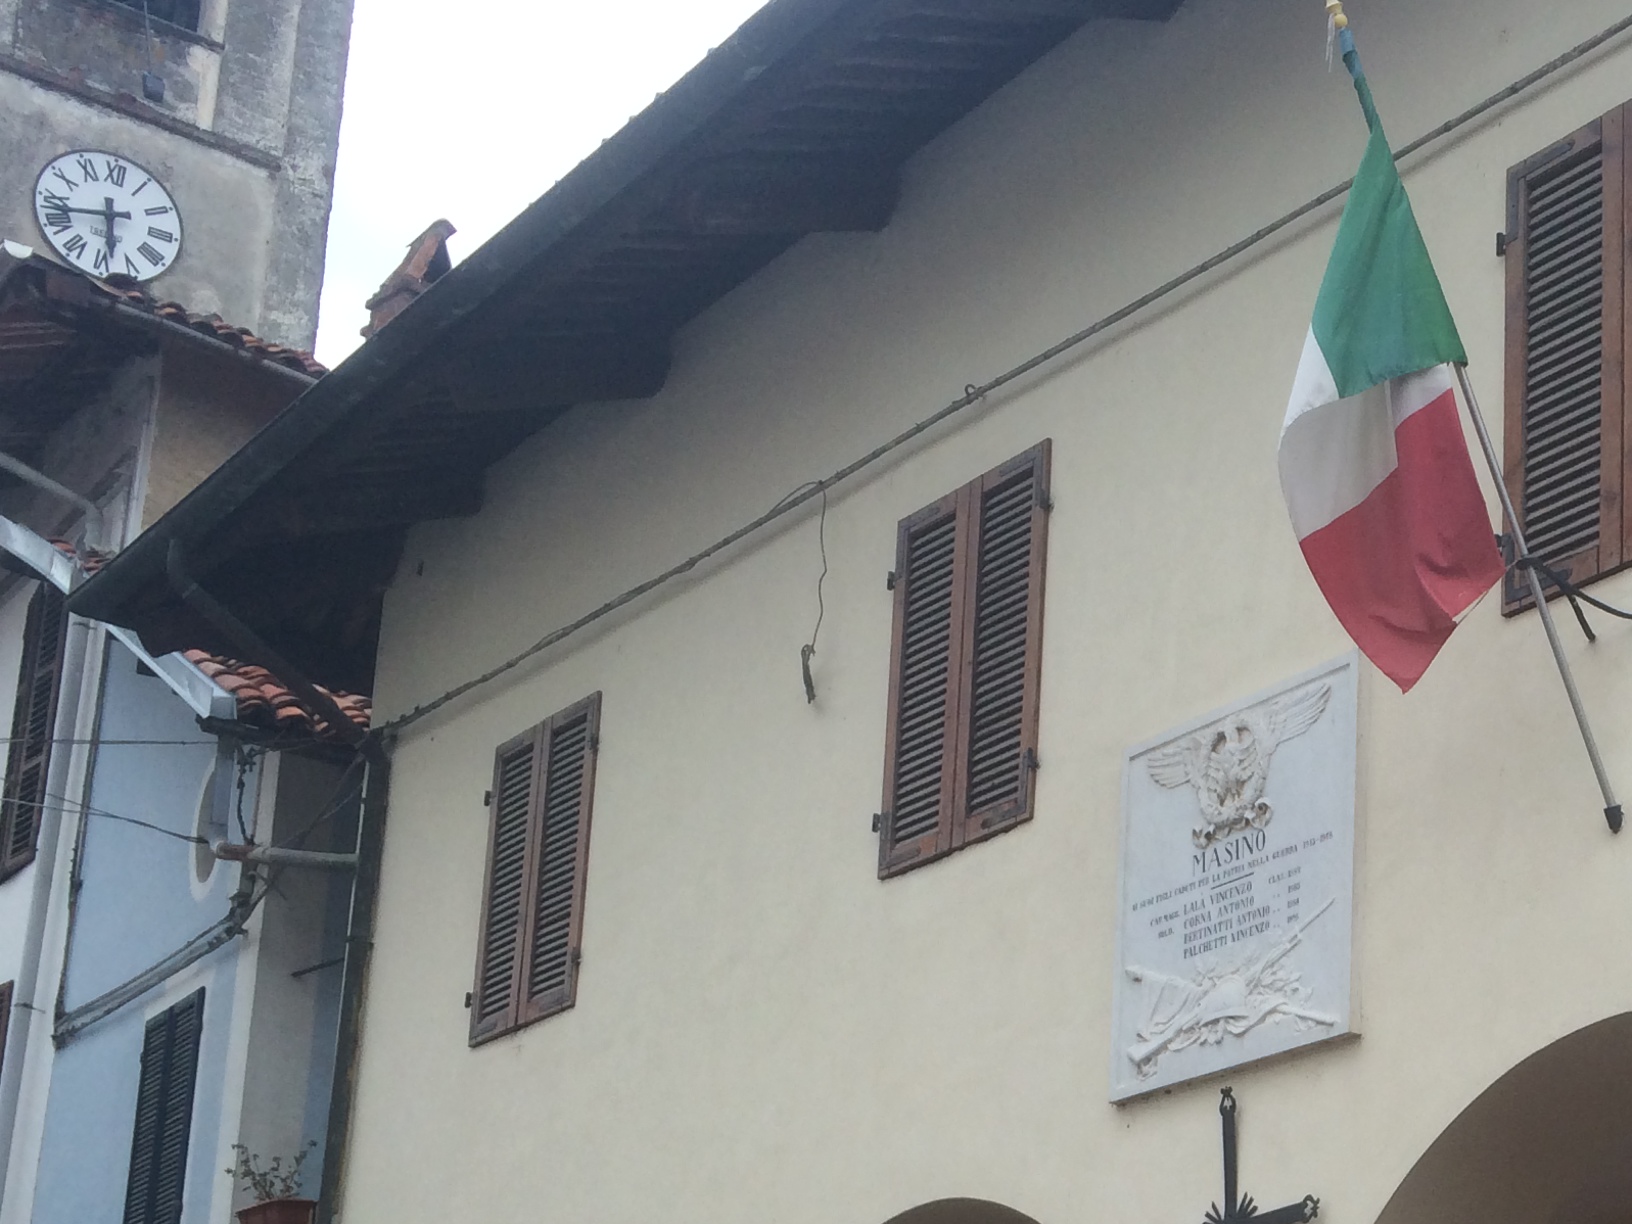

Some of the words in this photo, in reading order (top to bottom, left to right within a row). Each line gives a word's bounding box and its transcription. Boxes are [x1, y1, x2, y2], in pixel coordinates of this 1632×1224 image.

[1191, 828, 1266, 877] MASINO
[1212, 872, 1221, 883] LA
[1247, 854, 1270, 869] NELLA
[1183, 898, 1206, 916] LALA
[1210, 881, 1253, 907] VINCENZO
[1183, 910, 1212, 930] CORNA
[1216, 896, 1255, 920] ANTONIO
[1230, 920, 1271, 944] VINCENZO
[1236, 904, 1271, 929] ANTONIO
